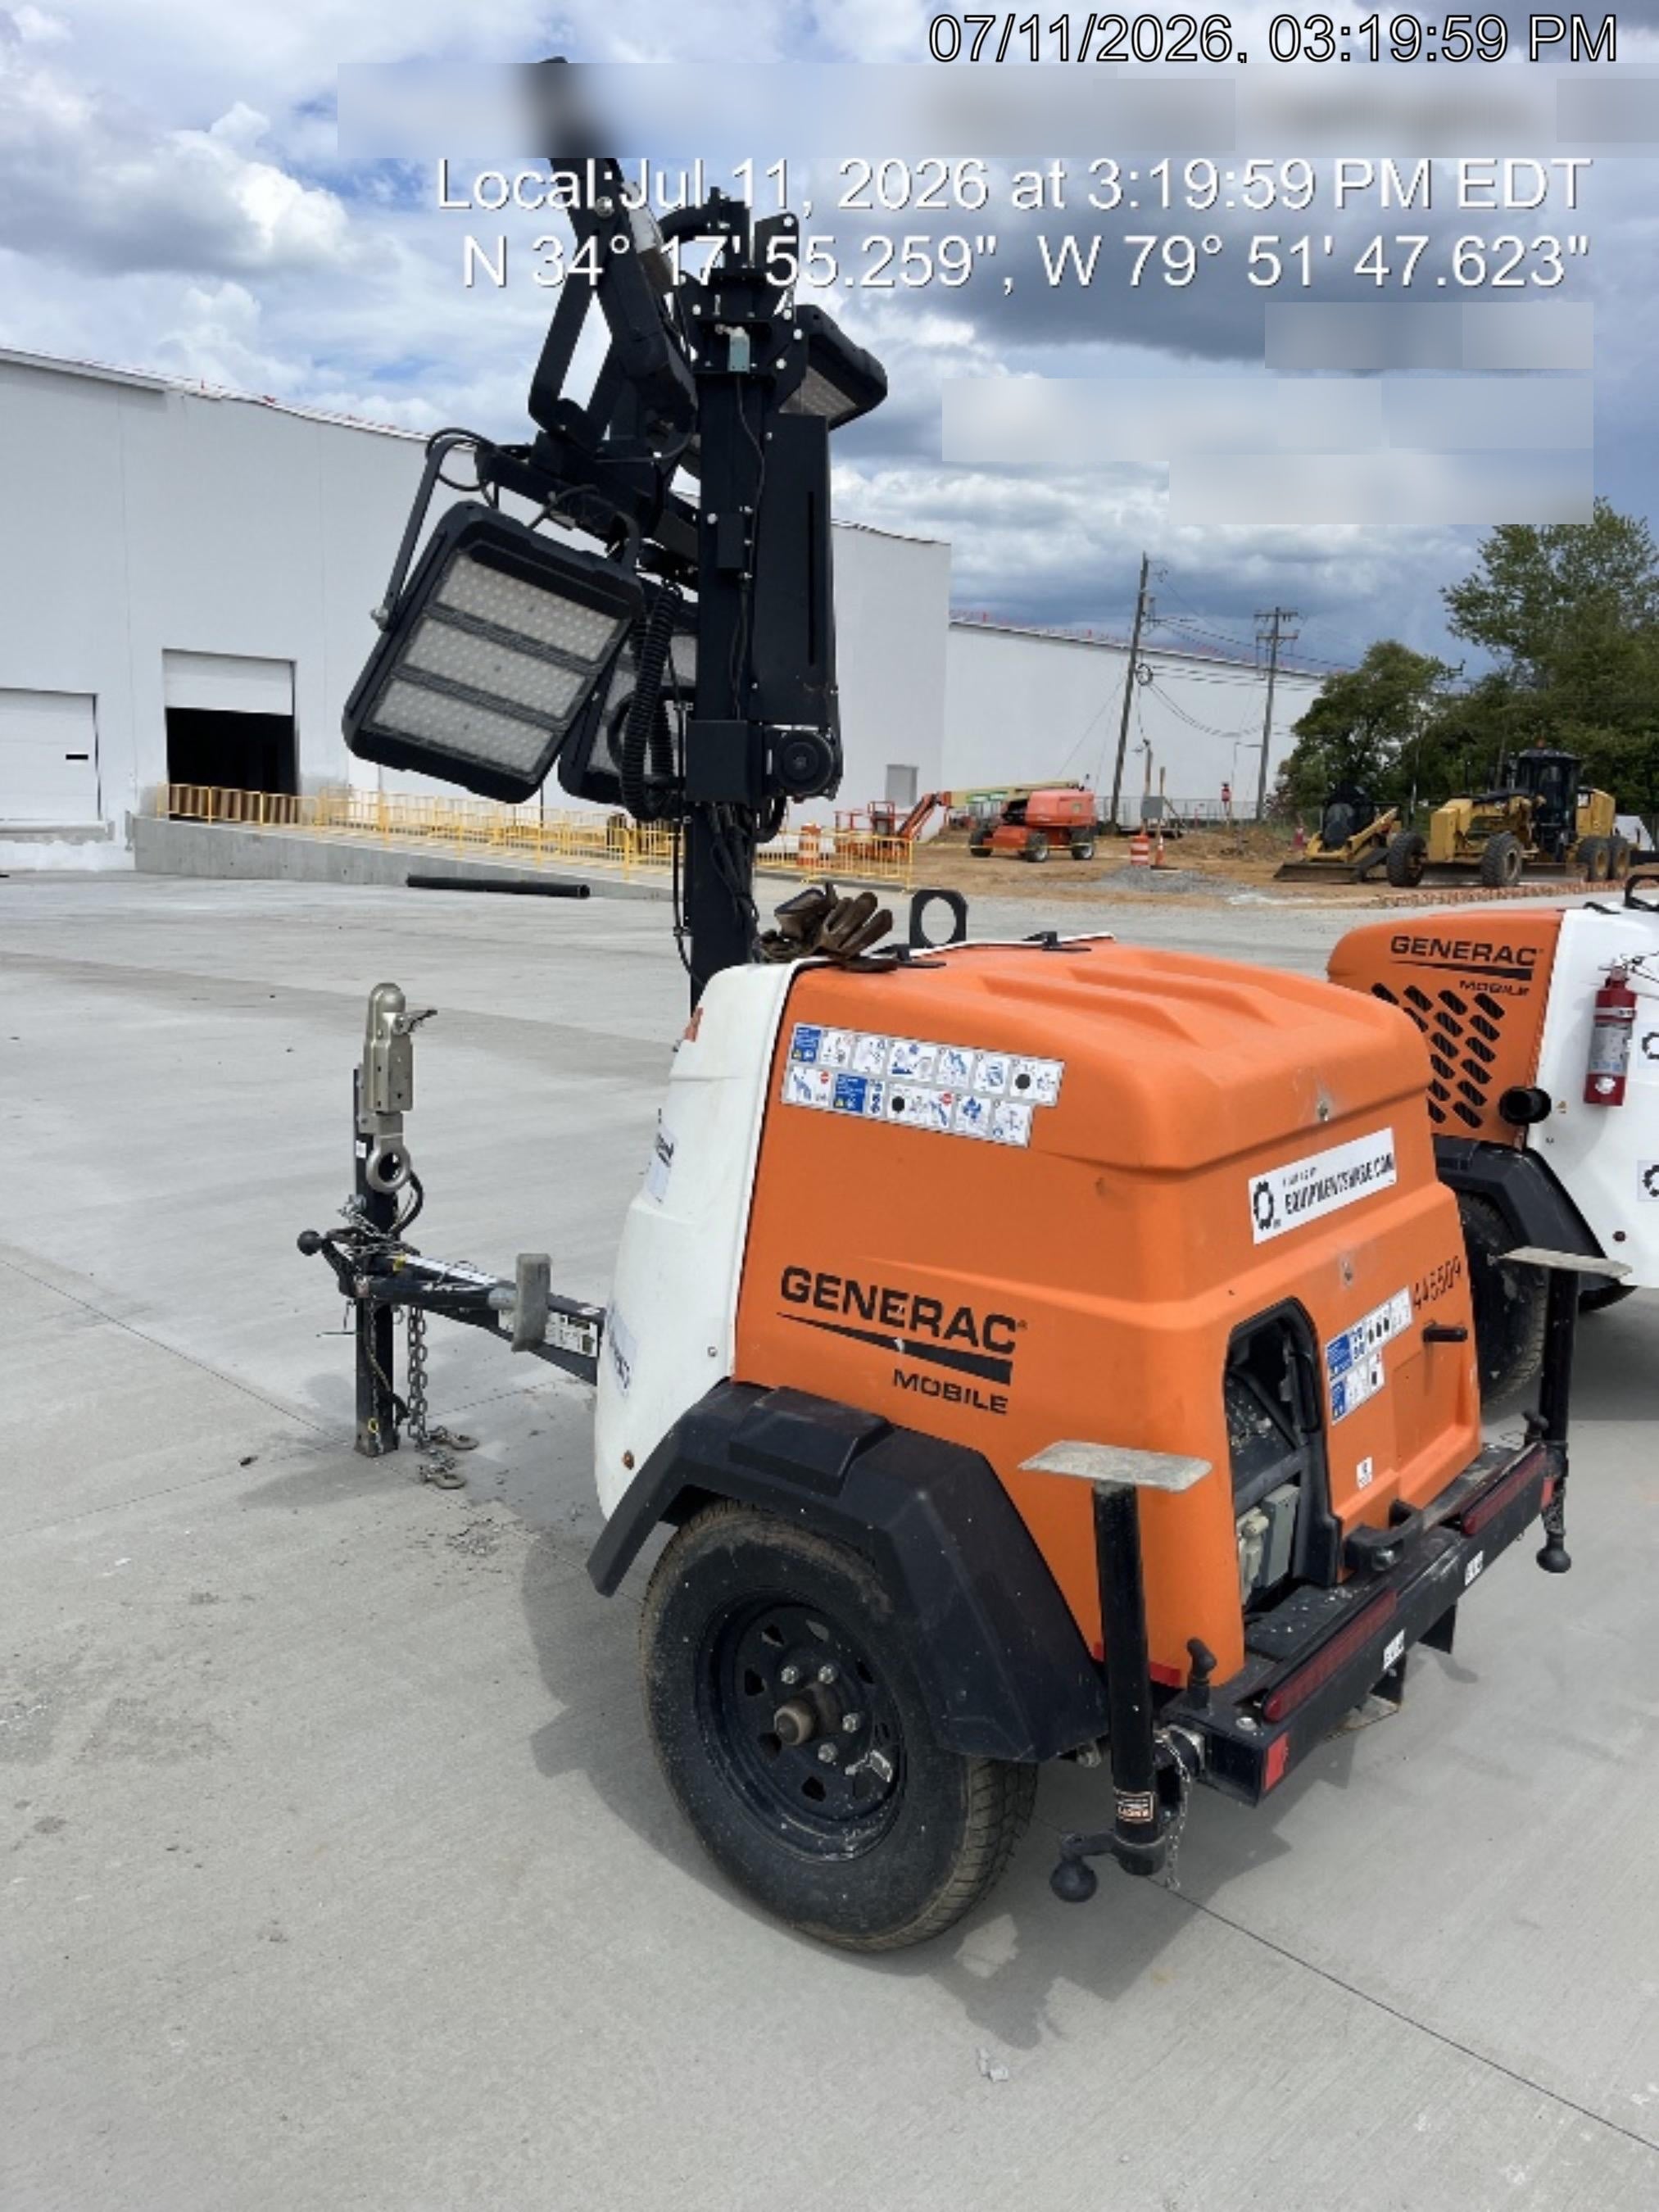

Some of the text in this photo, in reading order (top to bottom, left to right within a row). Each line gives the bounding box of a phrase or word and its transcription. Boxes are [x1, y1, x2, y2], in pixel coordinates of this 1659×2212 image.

[1390, 936, 1537, 967] GENERAC
[781, 1265, 1017, 1355] GENERAC
[892, 1367, 1009, 1416] MOBILE
